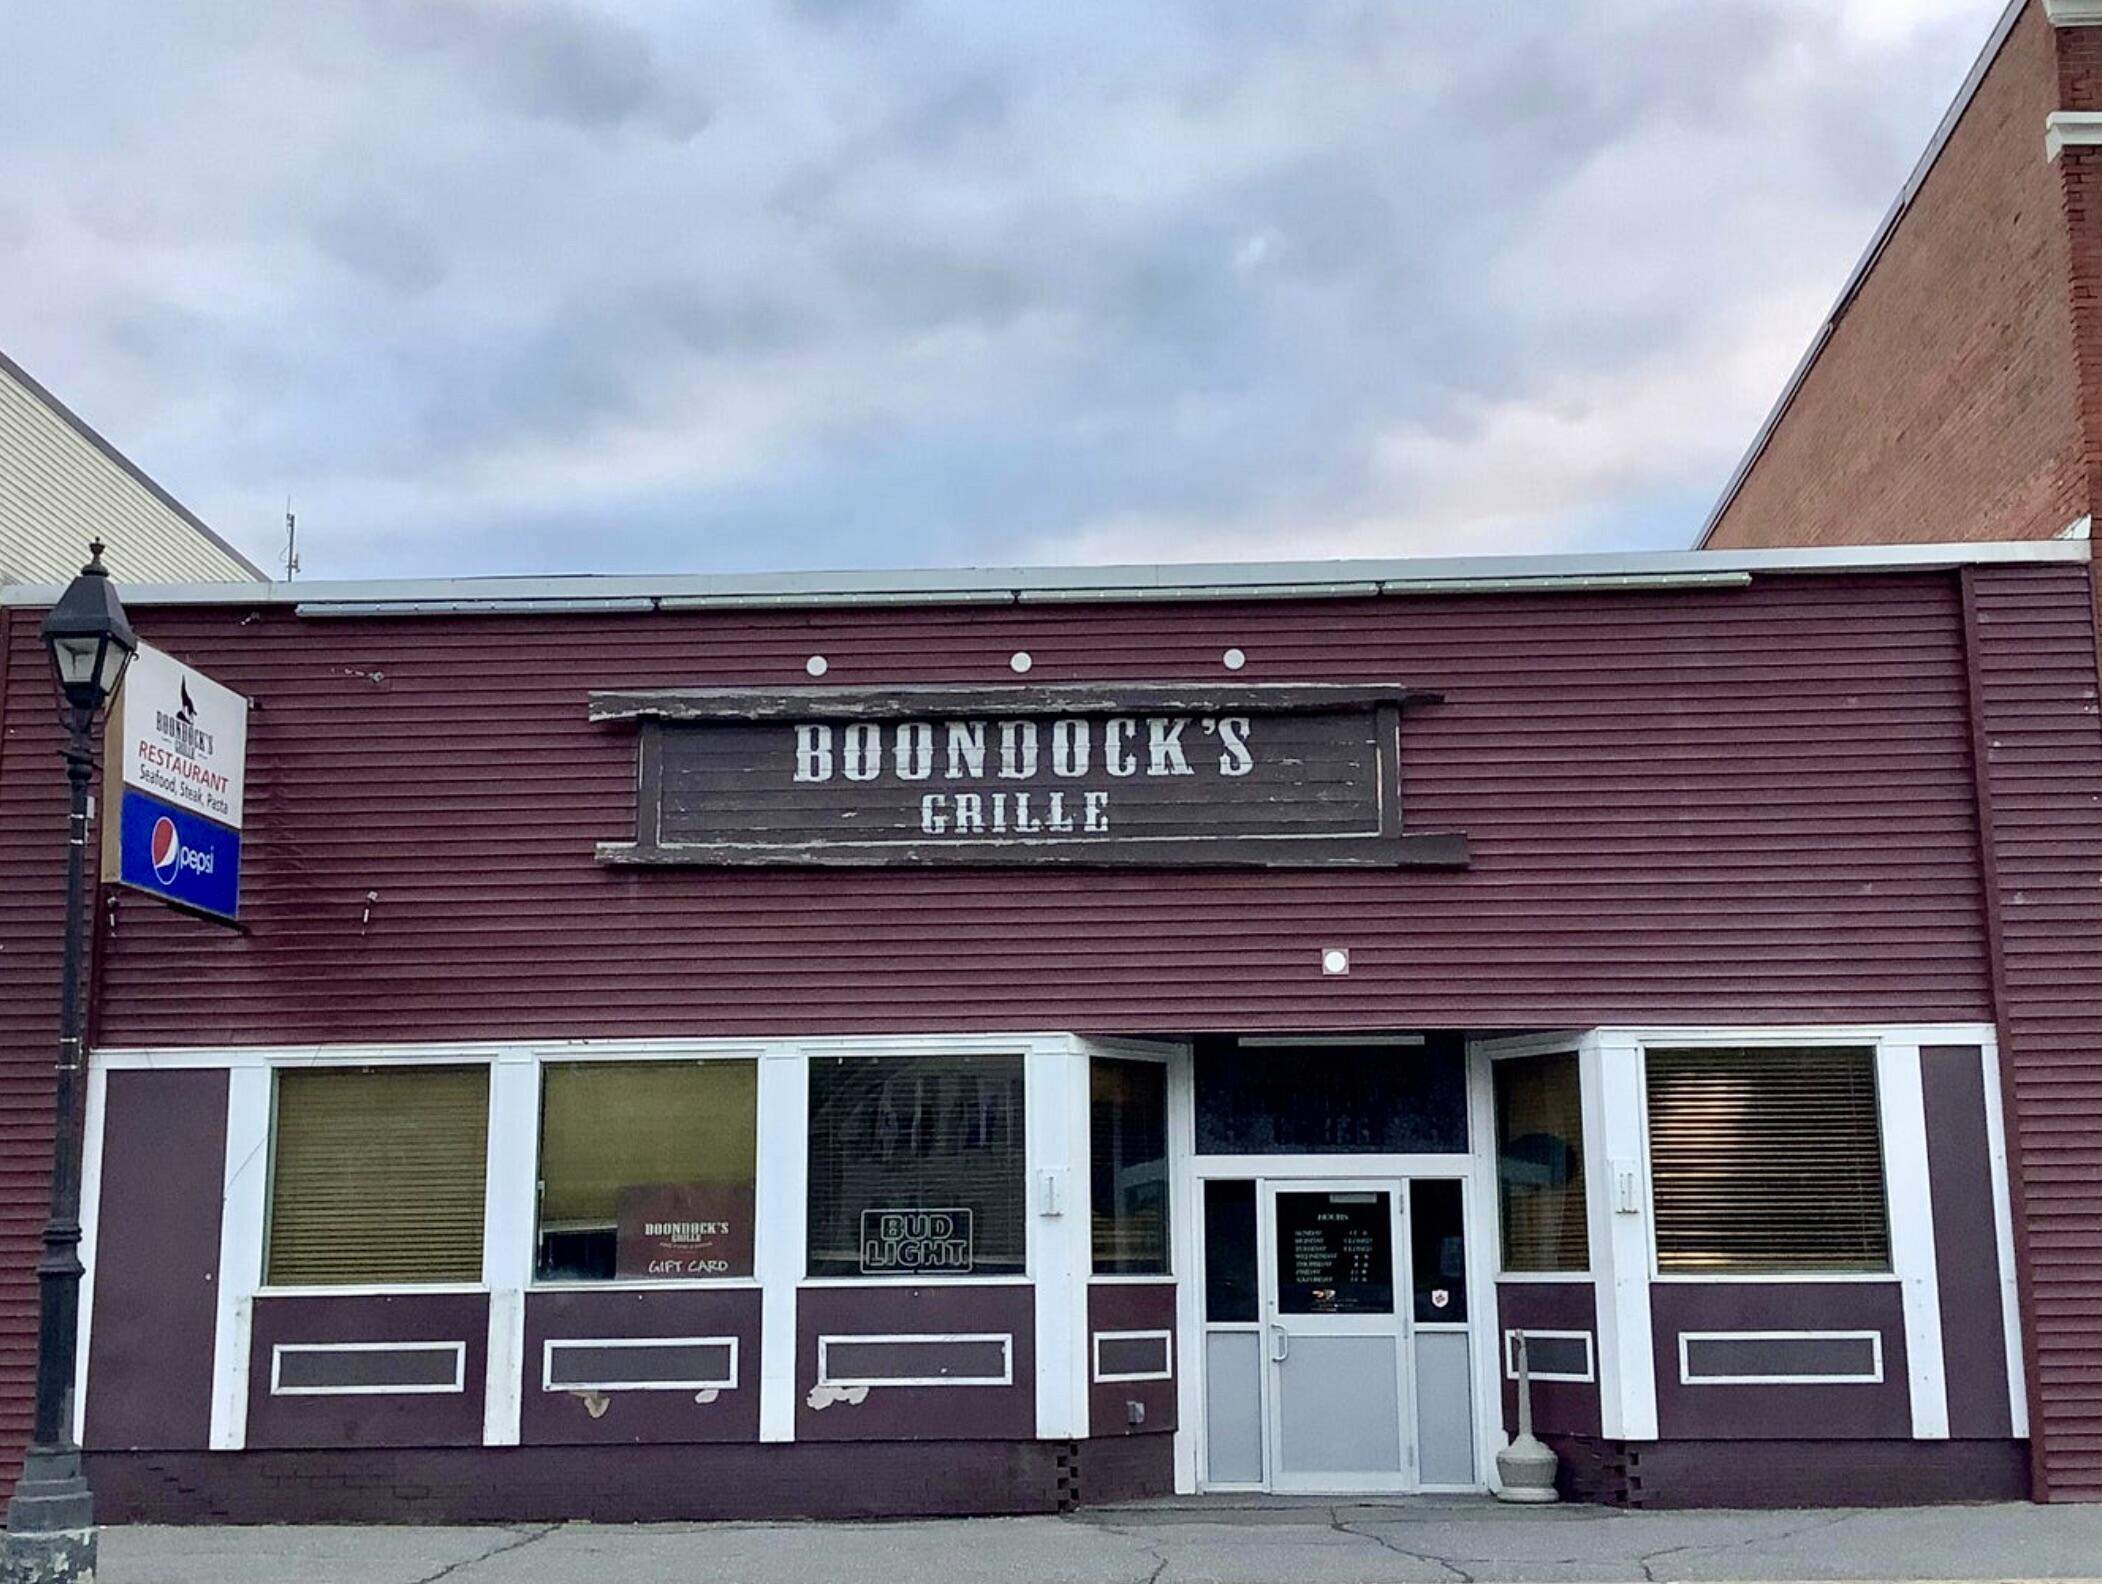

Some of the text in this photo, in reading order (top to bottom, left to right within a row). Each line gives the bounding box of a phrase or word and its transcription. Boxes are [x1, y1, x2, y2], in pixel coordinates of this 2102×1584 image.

[793, 717, 1254, 782] BOONDOCK'S
[139, 741, 229, 794] RESTAURANT
[139, 763, 177, 796] Seafood,
[207, 793, 229, 815] Pasta
[920, 791, 1109, 834] GRILLE
[180, 845, 215, 876] pepsi
[645, 1222, 729, 1235] BOONDOCK'S
[881, 1214, 953, 1240] BUD
[648, 1260, 729, 1273] GIFT CARD
[866, 1240, 967, 1266] LIGHT
